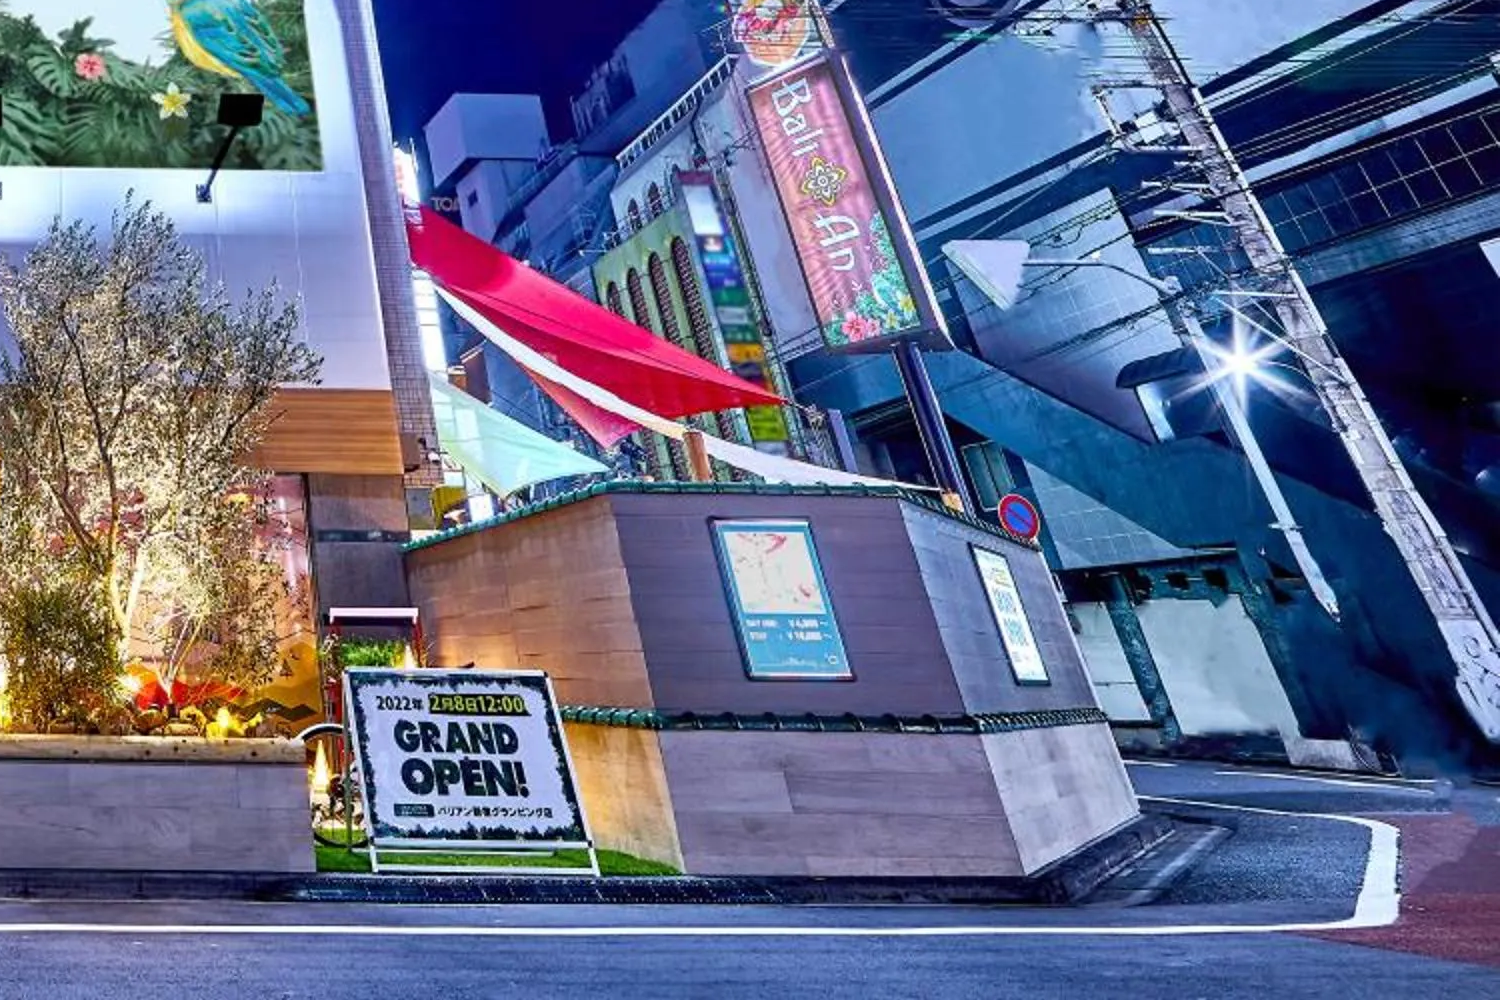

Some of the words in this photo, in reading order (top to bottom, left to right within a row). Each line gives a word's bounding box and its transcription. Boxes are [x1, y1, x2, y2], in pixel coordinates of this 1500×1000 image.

[770, 75, 826, 158] Bali
[812, 212, 862, 273] An
[393, 719, 519, 755] GRAND
[401, 757, 530, 798] OPEN!
